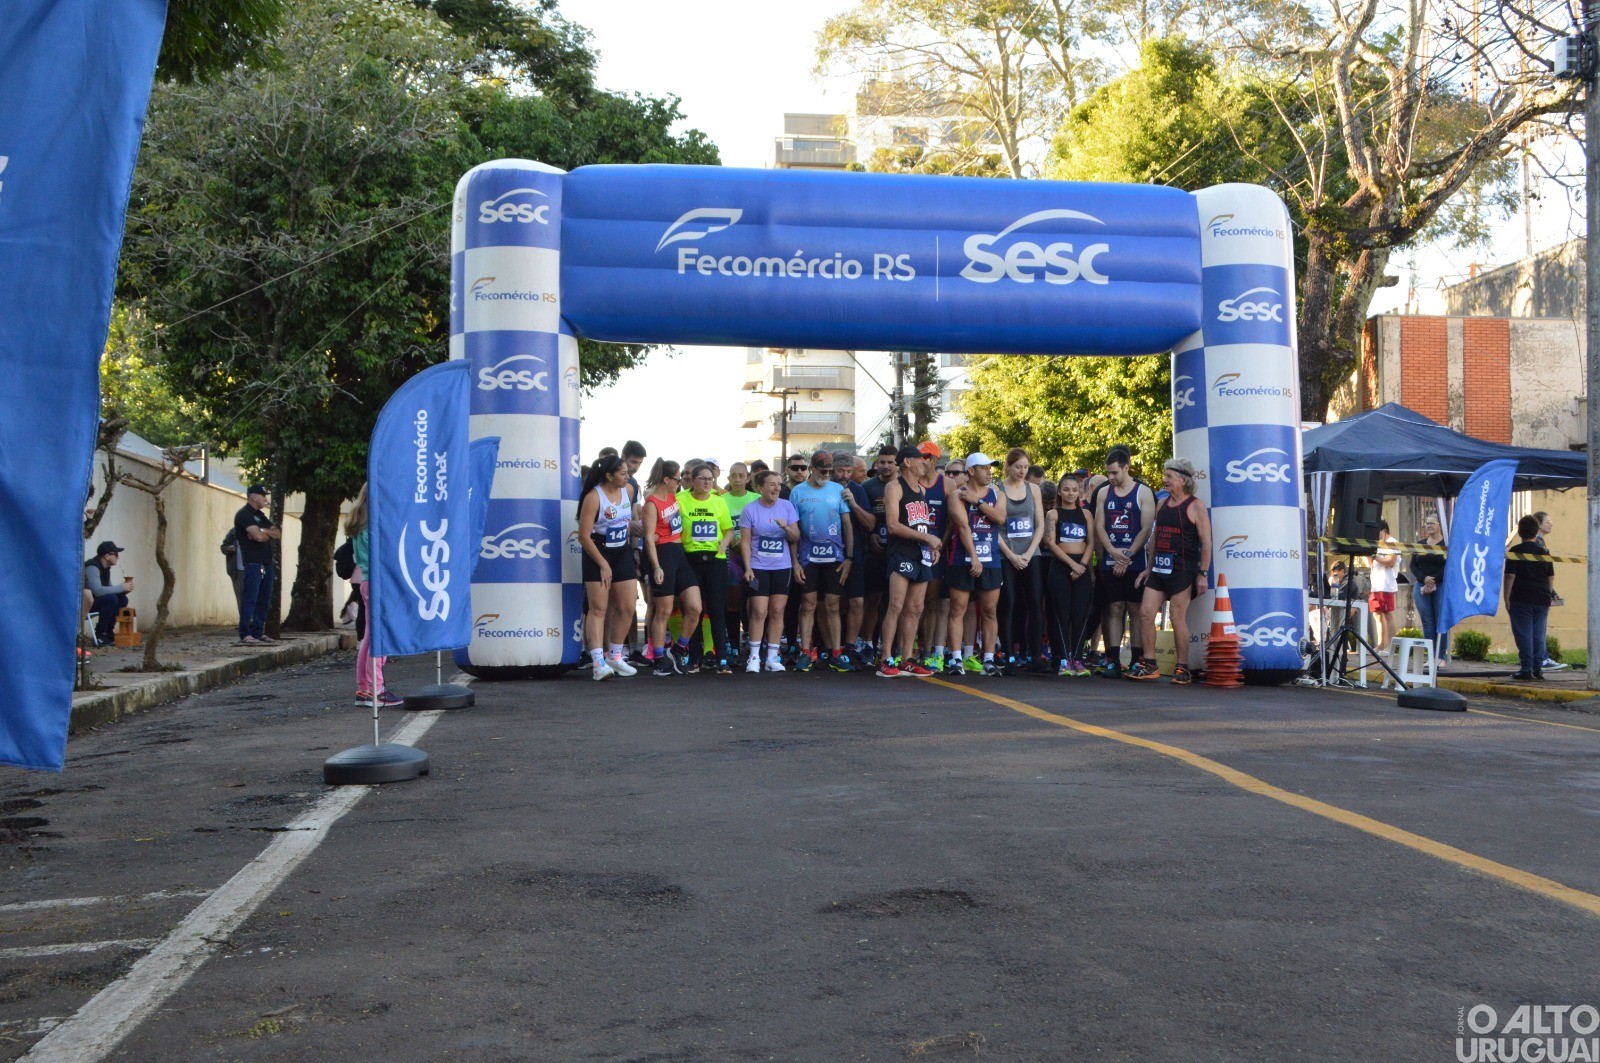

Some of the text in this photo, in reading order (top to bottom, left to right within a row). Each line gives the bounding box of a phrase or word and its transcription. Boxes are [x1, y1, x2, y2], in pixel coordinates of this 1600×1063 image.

[1213, 227, 1285, 240] Fecomércio RS
[678, 247, 916, 282] Fecomércio RS
[475, 290, 556, 303] Fecomércio RS
[1220, 386, 1292, 398] Fecomércio RS
[413, 409, 428, 504] Fecomércio
[495, 458, 541, 469] omércio
[544, 459, 558, 470] RS
[694, 525, 716, 534] 012
[1010, 520, 1031, 531] 185
[609, 529, 627, 540] 147
[1063, 526, 1085, 537] 148
[761, 540, 783, 550] 022
[812, 545, 834, 555] 024
[1226, 549, 1299, 560] Fecomércio RS
[1154, 556, 1171, 567] 150
[478, 628, 560, 638] Fecomércio RS
